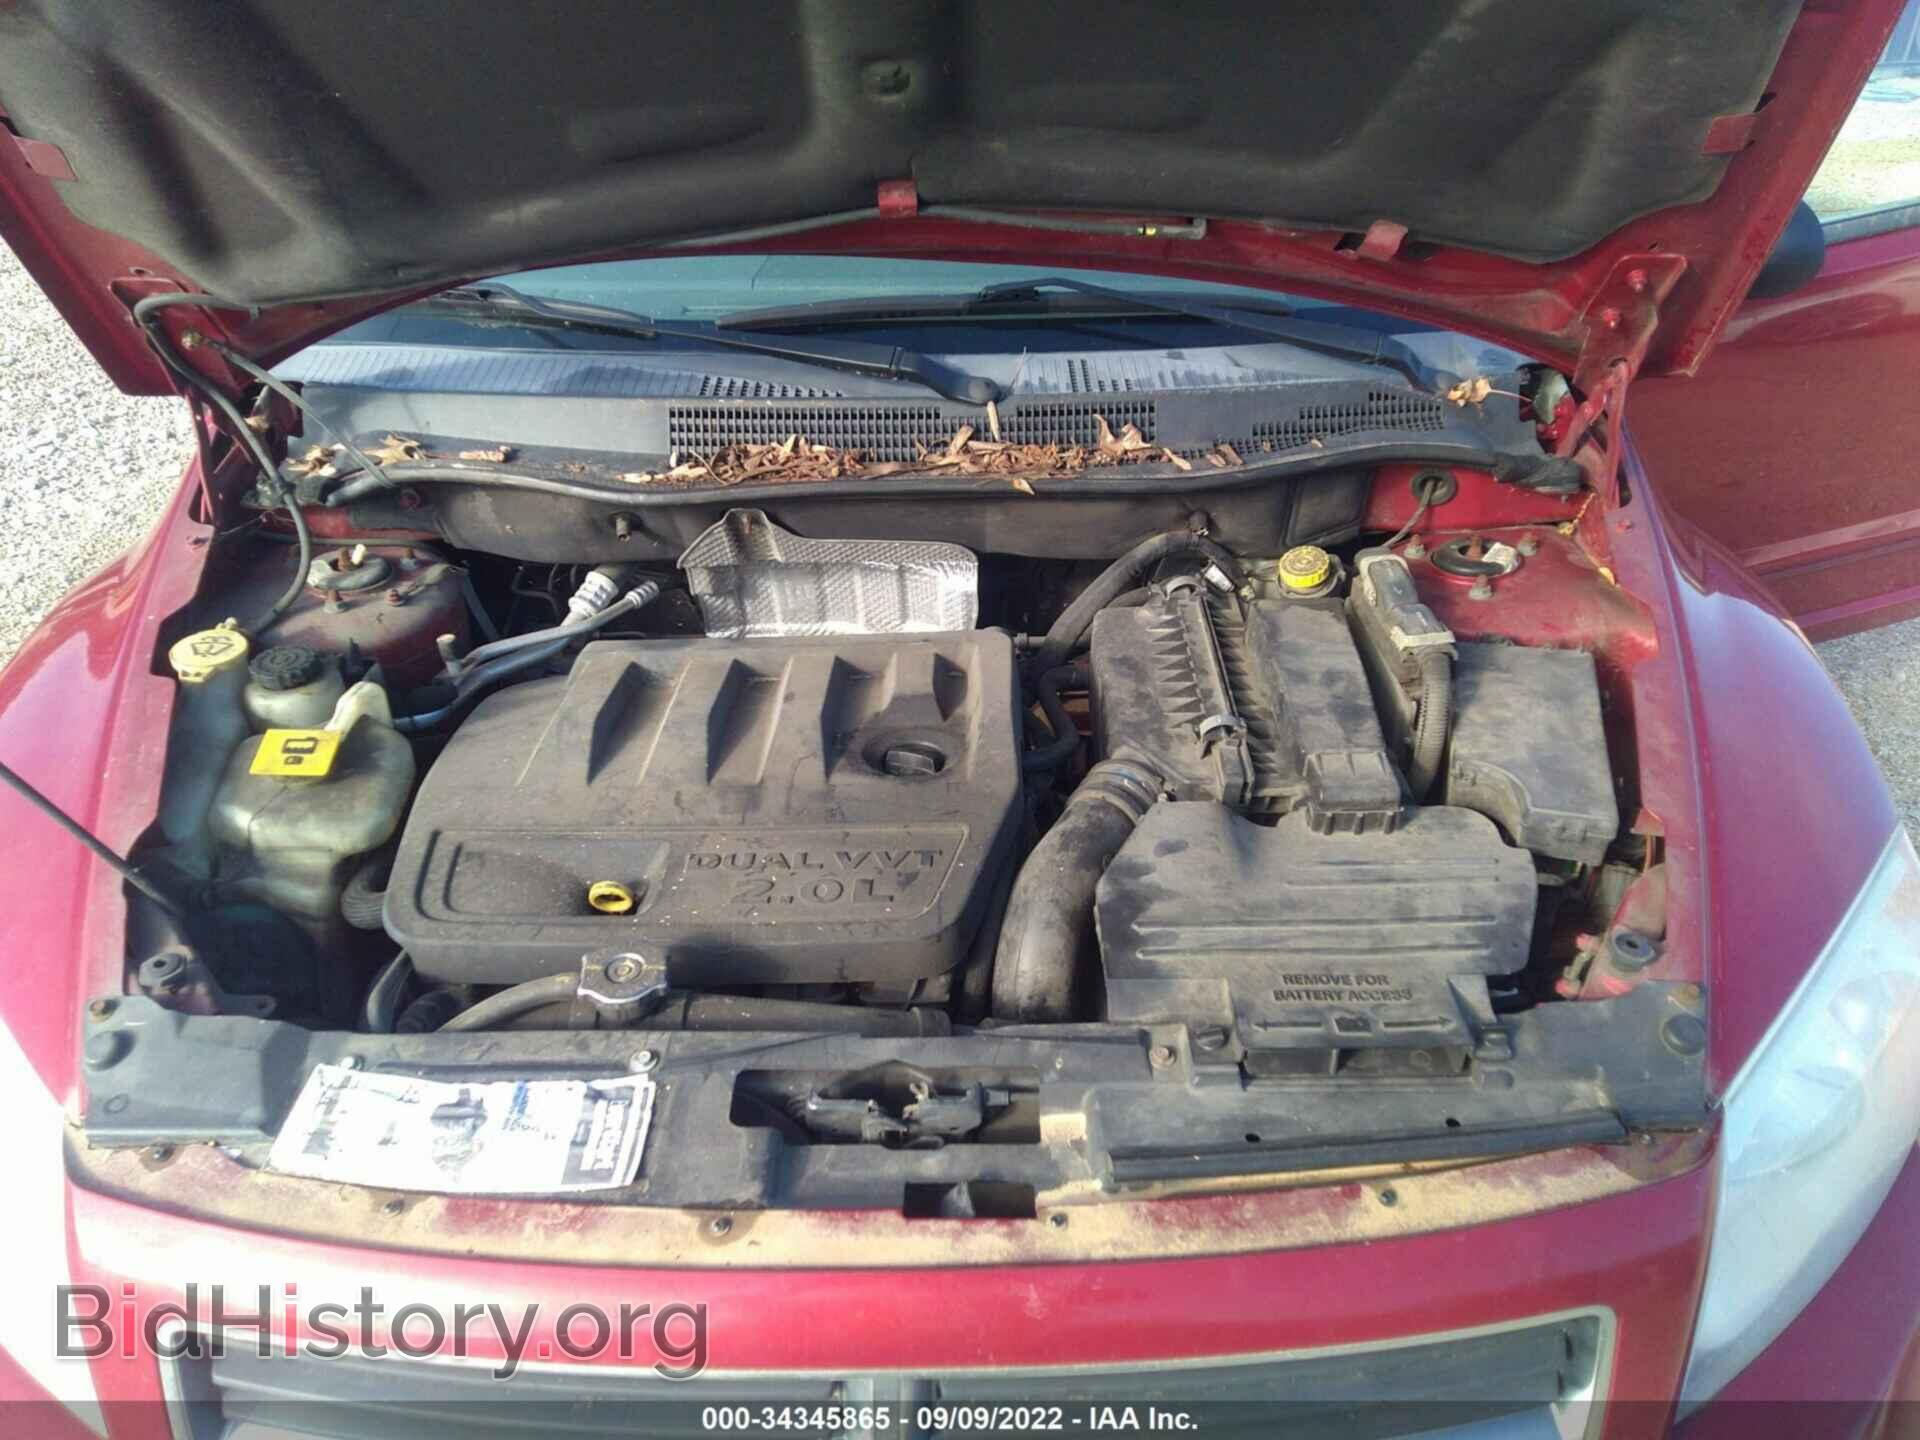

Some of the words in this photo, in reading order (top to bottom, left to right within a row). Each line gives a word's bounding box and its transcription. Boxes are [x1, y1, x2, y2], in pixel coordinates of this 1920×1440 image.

[688, 851, 824, 870] DUAL
[834, 850, 943, 869] VVT
[730, 877, 895, 904] 2.0L
[1282, 974, 1352, 986] REMOVE
[1356, 974, 1390, 986] FOR
[1272, 990, 1345, 1002] BATTERY
[1347, 989, 1413, 1002] ACCESS
